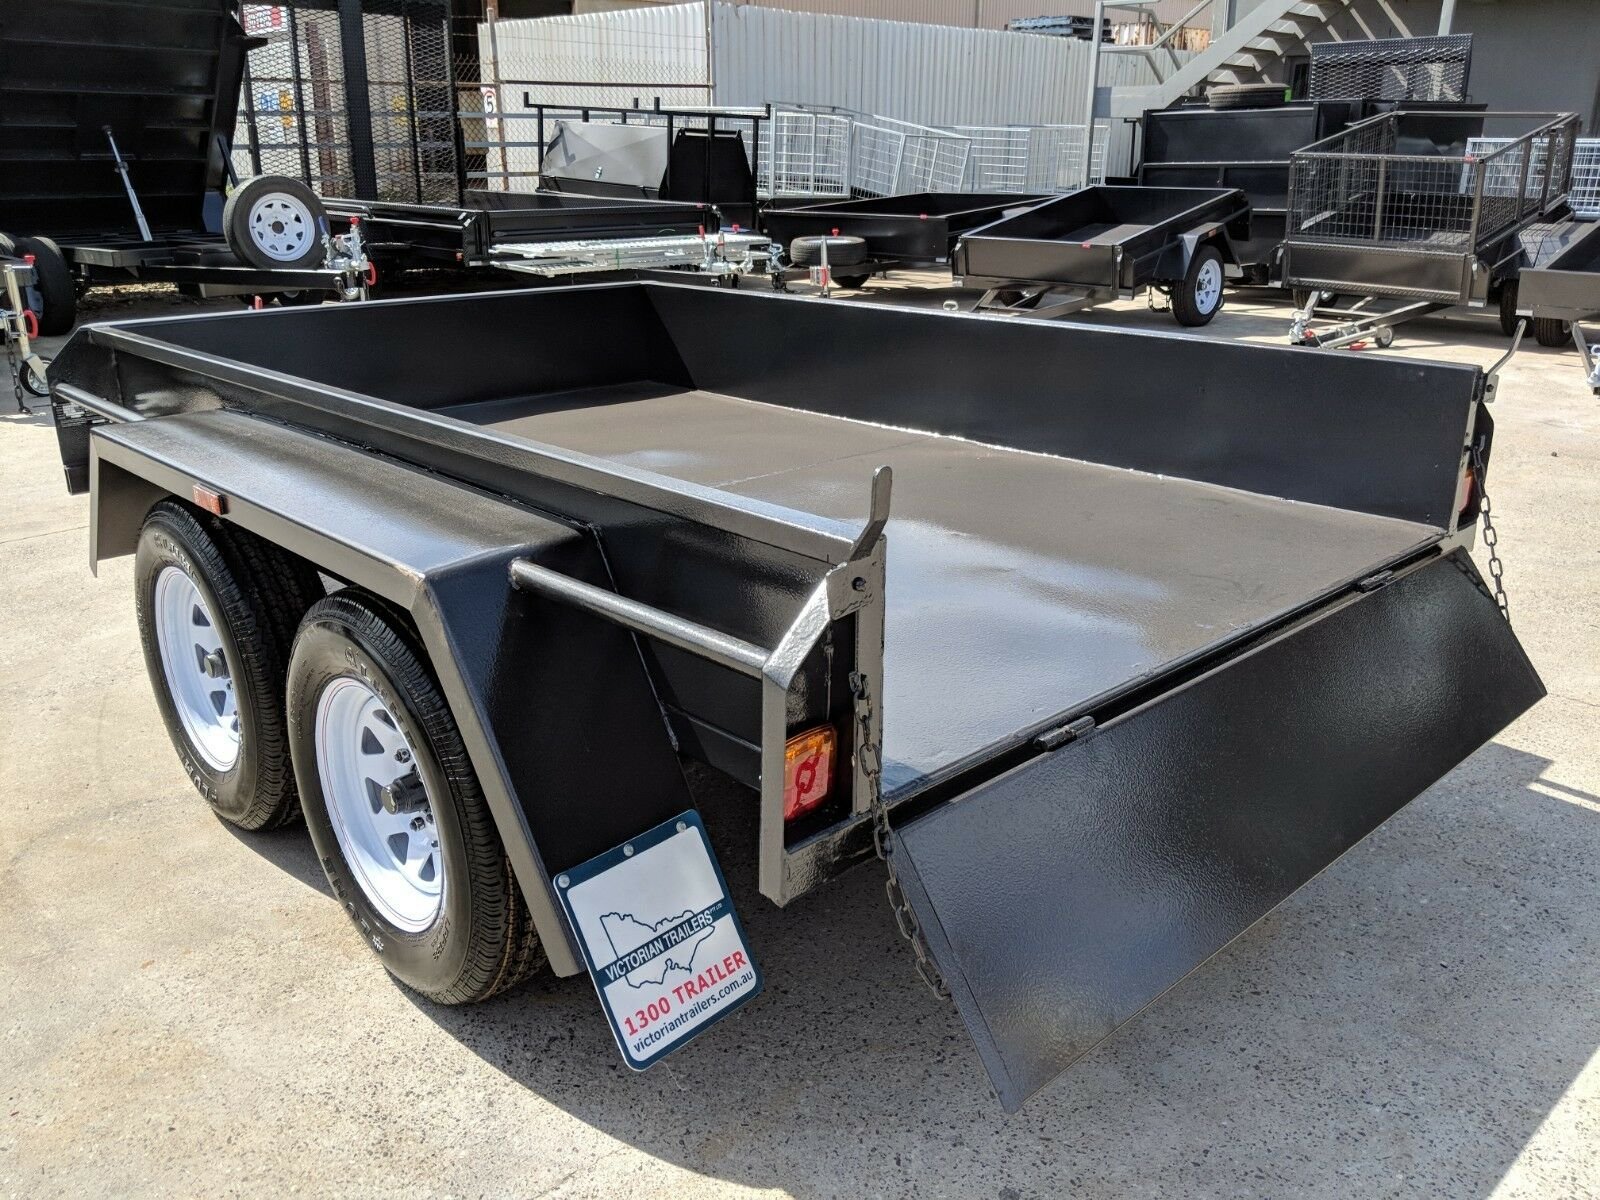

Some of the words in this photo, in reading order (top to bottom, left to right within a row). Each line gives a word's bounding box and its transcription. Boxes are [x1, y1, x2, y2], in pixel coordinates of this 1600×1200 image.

[605, 940, 664, 981] VICTORIAN
[663, 910, 713, 948] TRAILERS
[624, 996, 671, 1037] 1300
[672, 950, 747, 1000] TRAILER
[633, 970, 754, 1053] victoriantrailers.com.au
